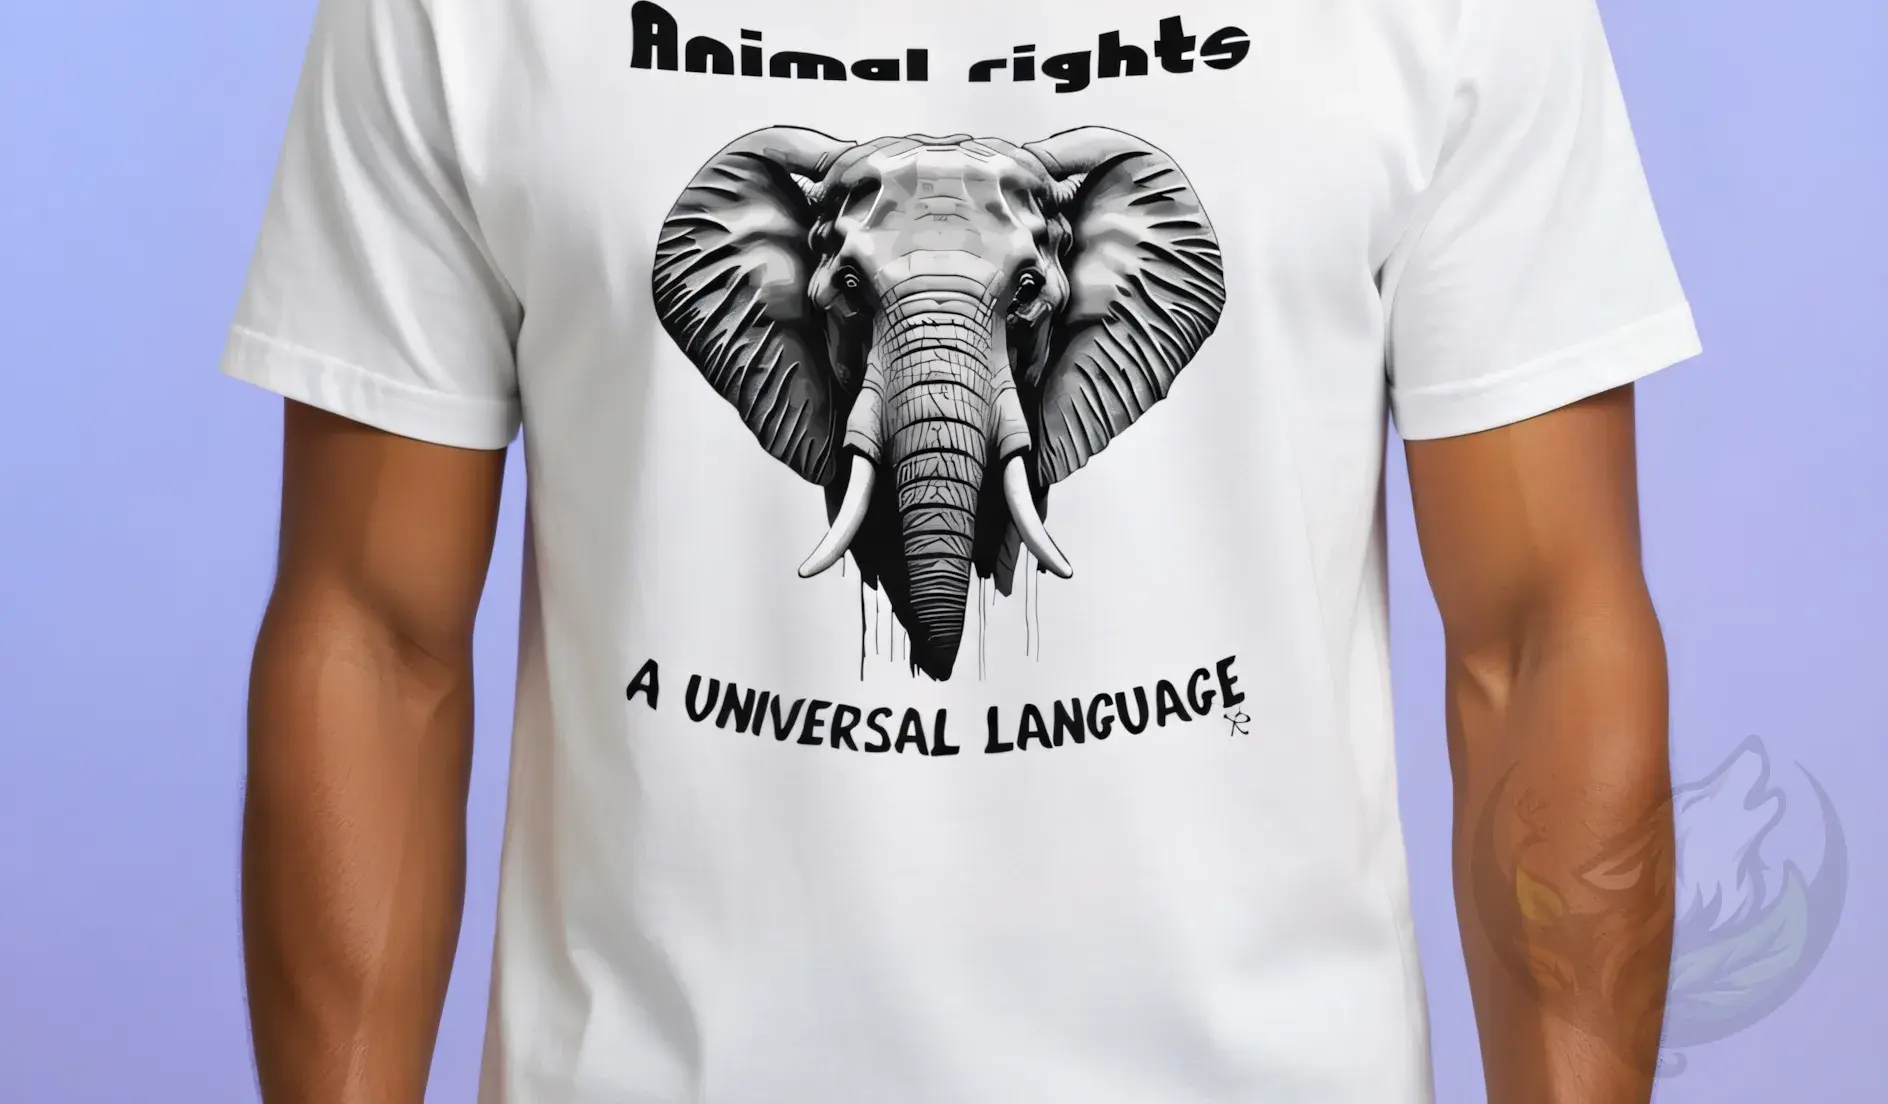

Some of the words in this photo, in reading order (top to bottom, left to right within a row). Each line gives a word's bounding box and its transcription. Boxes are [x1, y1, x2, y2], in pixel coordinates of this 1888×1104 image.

[630, 0, 929, 82] Animal
[968, 15, 1251, 94] rights
[625, 658, 660, 711] A
[685, 674, 960, 757] UNIVERSAL
[984, 655, 1246, 754] LANGUAGE
